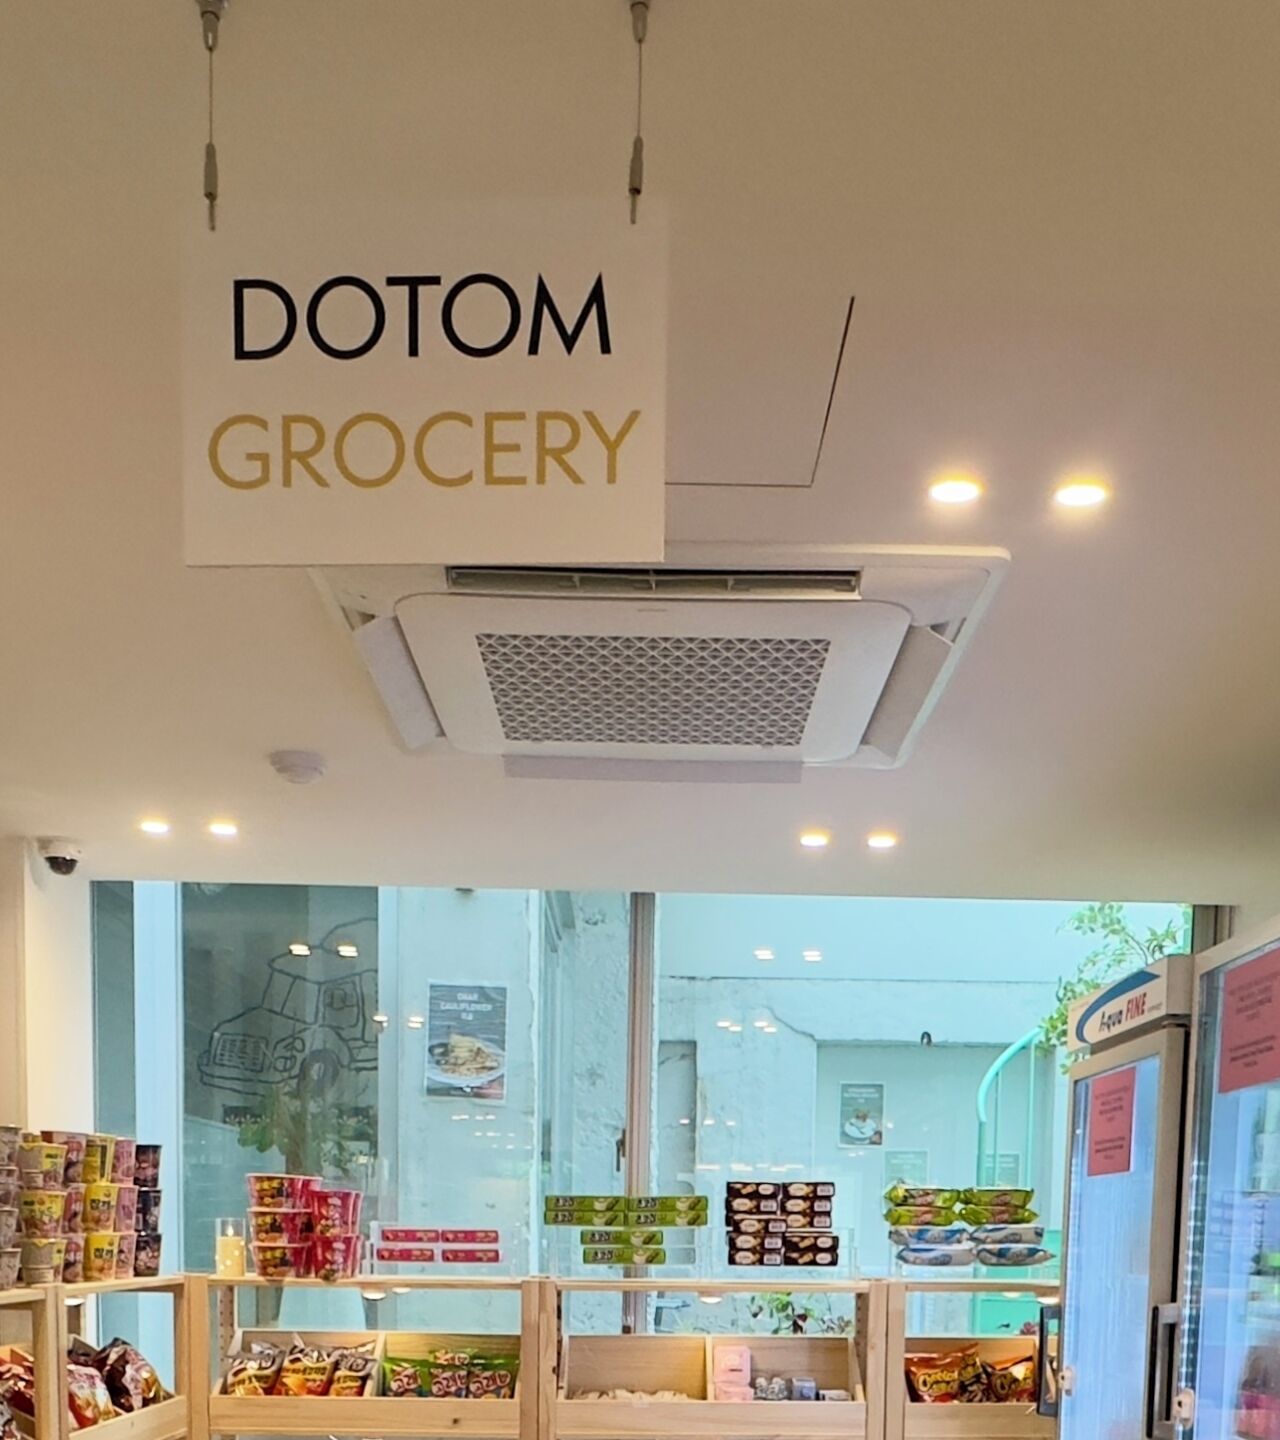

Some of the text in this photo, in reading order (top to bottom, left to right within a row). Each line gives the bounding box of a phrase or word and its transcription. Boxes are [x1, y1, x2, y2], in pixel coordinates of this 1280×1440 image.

[233, 271, 612, 361] DOTOM
[207, 409, 642, 491] GROCERY
[1124, 992, 1148, 1022] FINE
